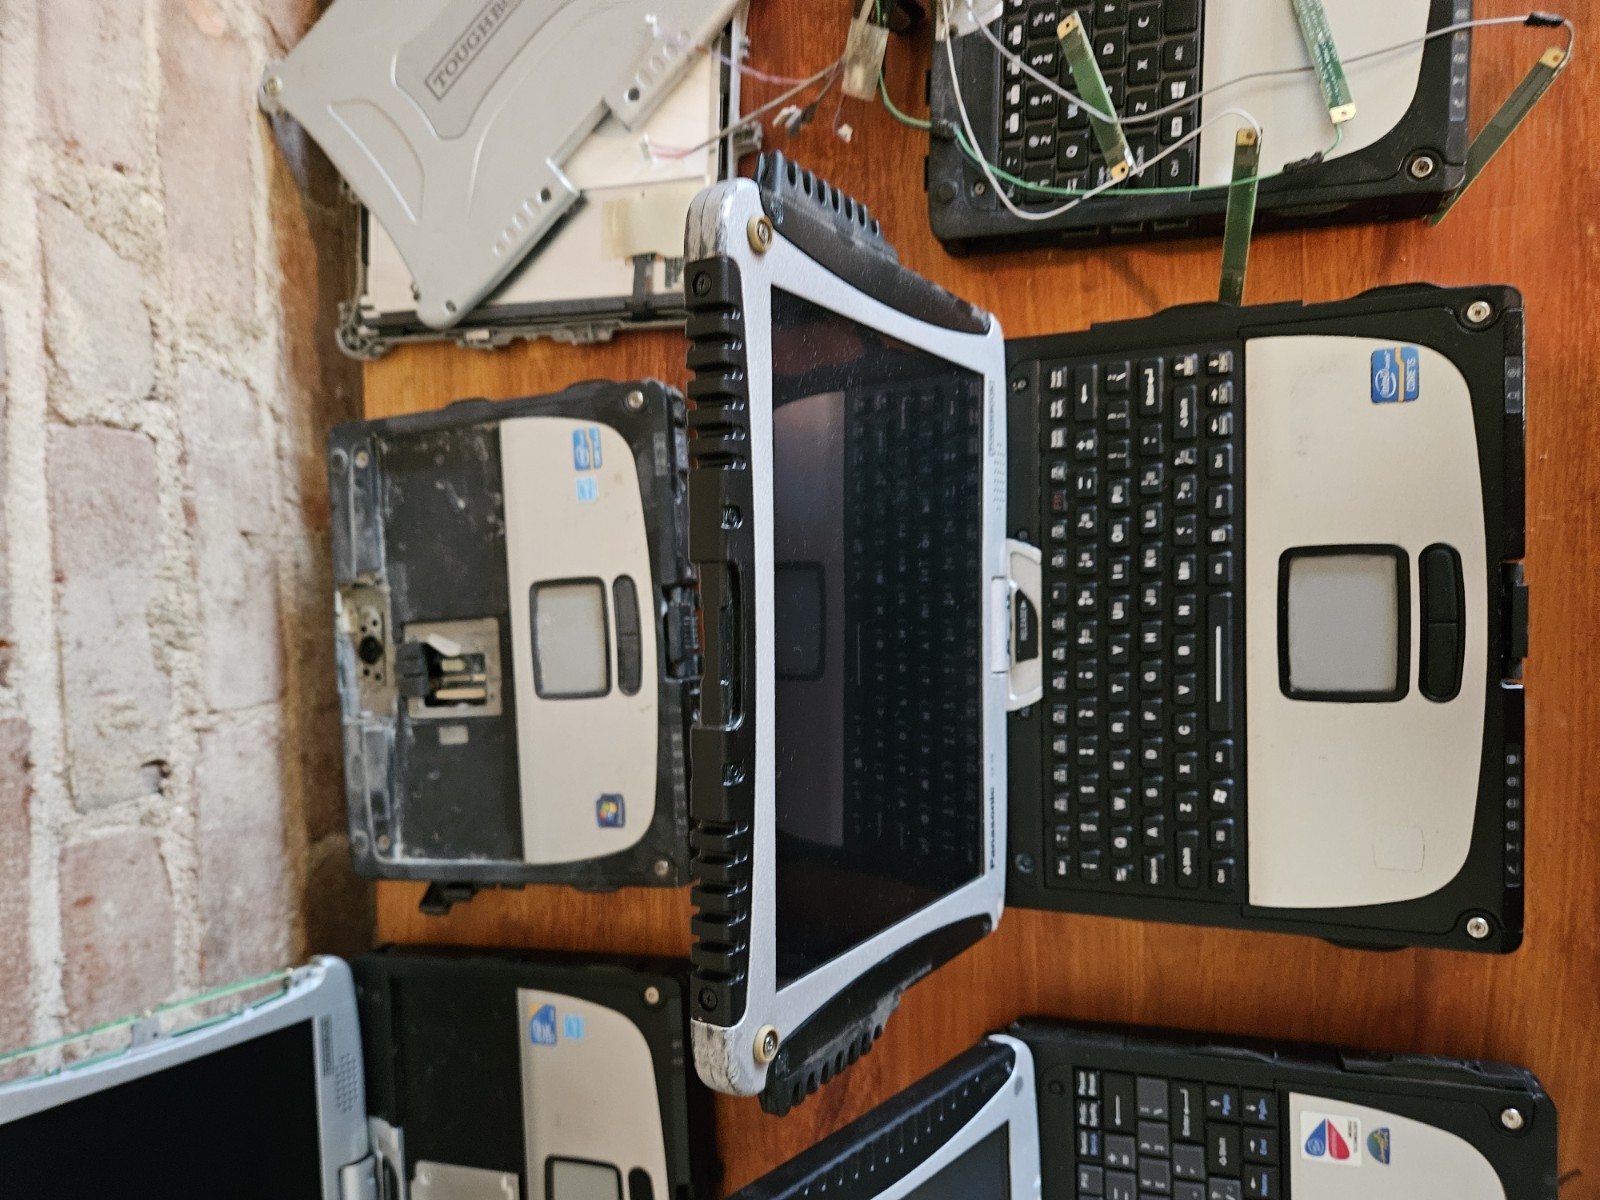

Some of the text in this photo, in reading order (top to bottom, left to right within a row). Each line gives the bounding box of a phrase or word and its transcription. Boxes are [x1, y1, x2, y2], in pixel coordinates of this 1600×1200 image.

[1104, 4, 1115, 12] F
[1138, 17, 1149, 27] C
[432, 0, 509, 89] TOUGHB
[1103, 43, 1114, 55] D
[1137, 59, 1148, 70] X
[1135, 102, 1147, 112] Z
[1066, 146, 1078, 158] Q
[1112, 684, 1123, 693] T
[1178, 686, 1189, 694] V
[1144, 712, 1156, 720] F
[1147, 827, 1158, 837] A
